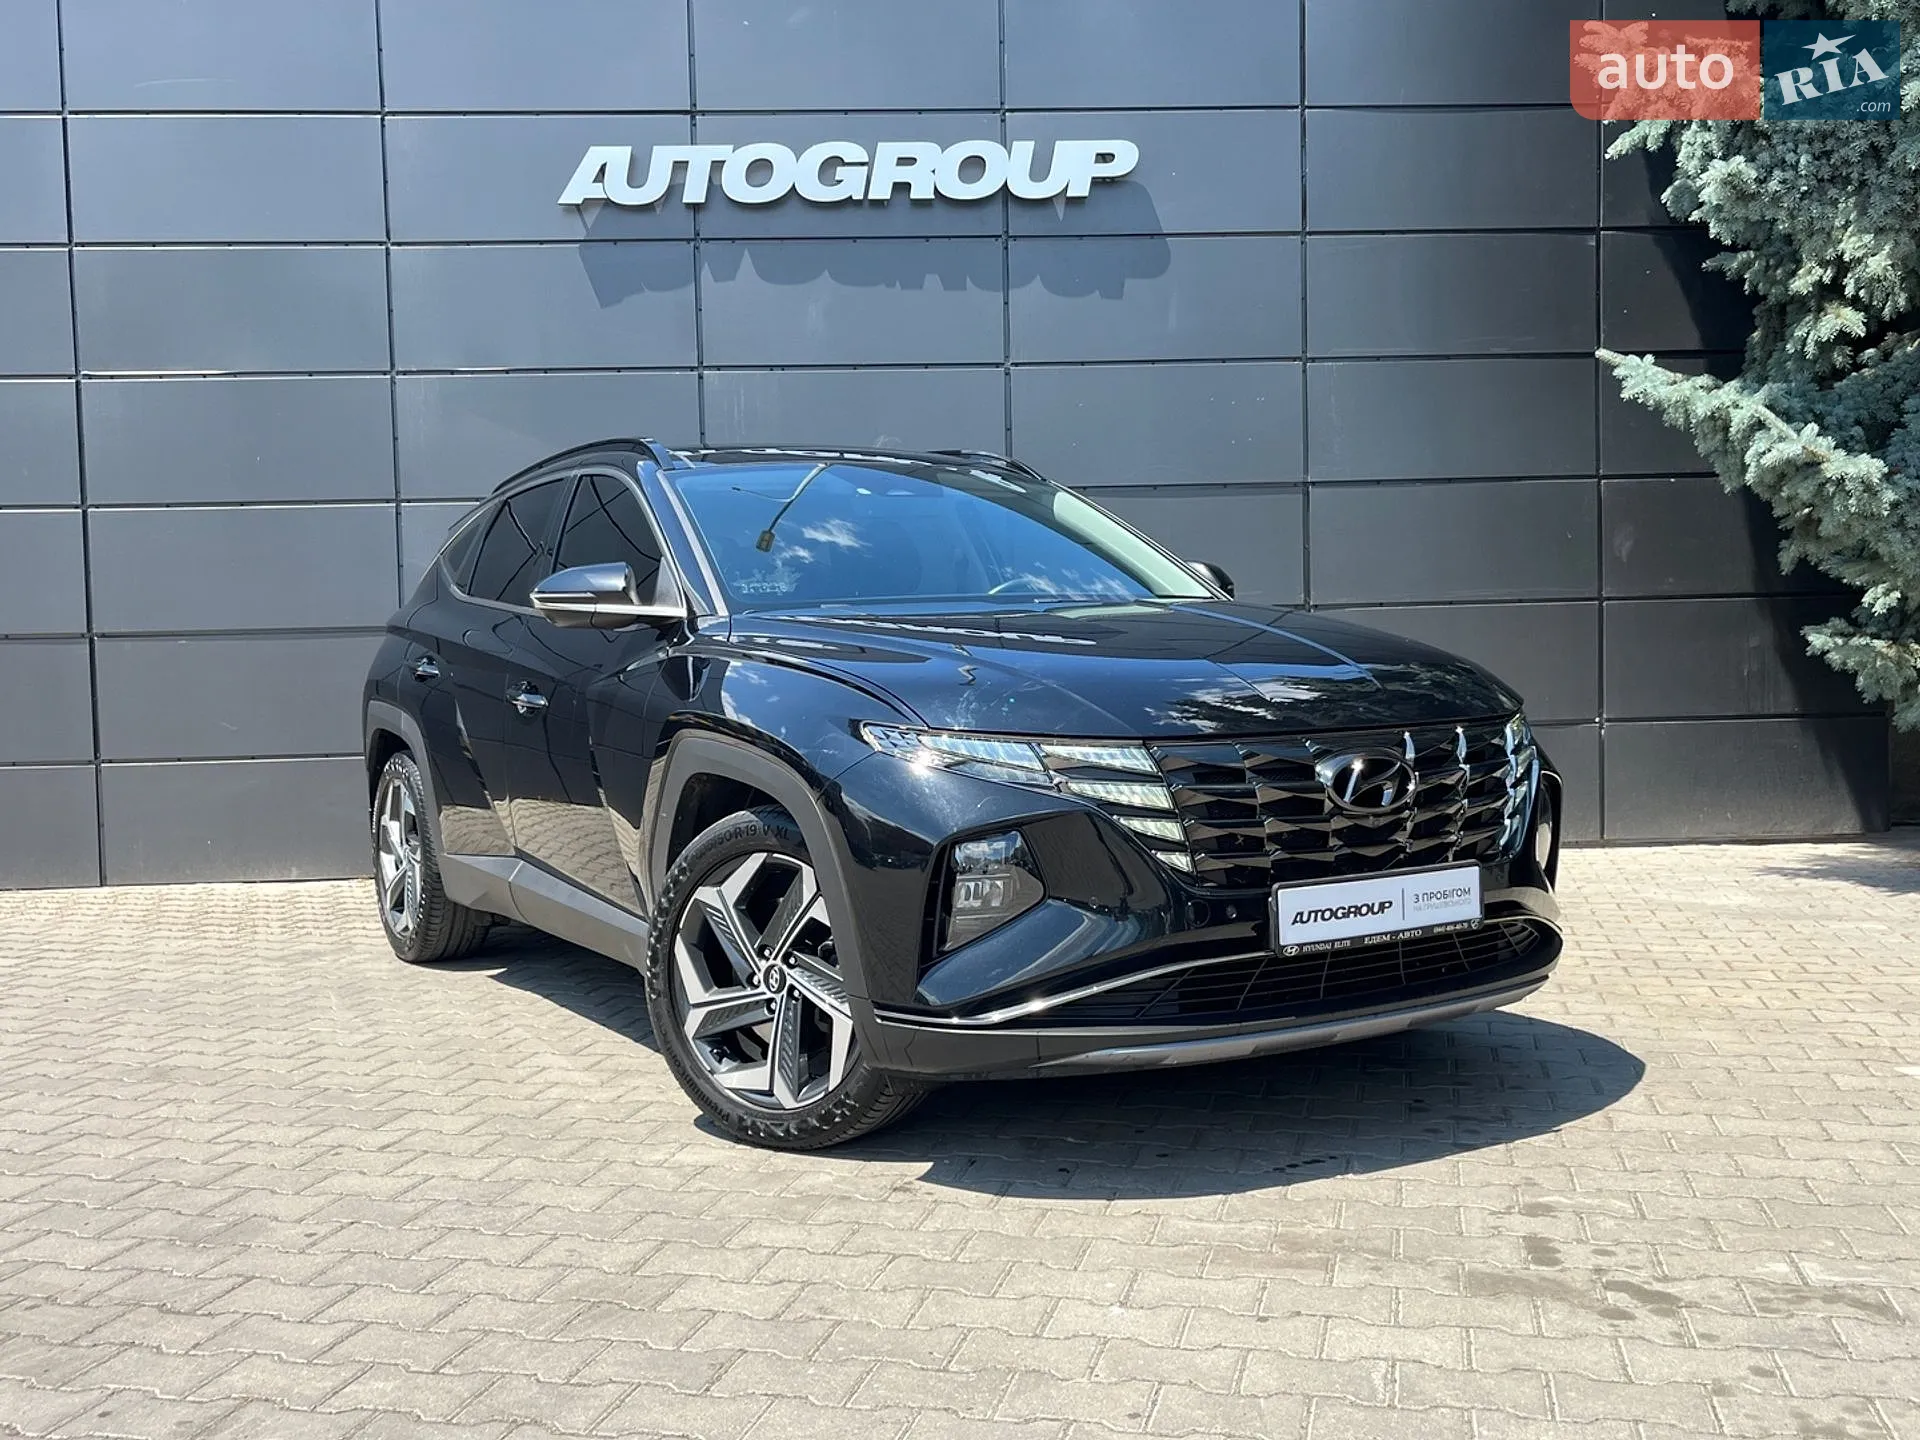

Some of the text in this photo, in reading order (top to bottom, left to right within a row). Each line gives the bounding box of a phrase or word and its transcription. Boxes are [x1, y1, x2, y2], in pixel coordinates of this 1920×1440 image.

[557, 139, 1140, 207] AUTOGROUP
[1421, 887, 1471, 902] ПРОБІГОМ
[1291, 900, 1394, 926] AUTOGROUP
